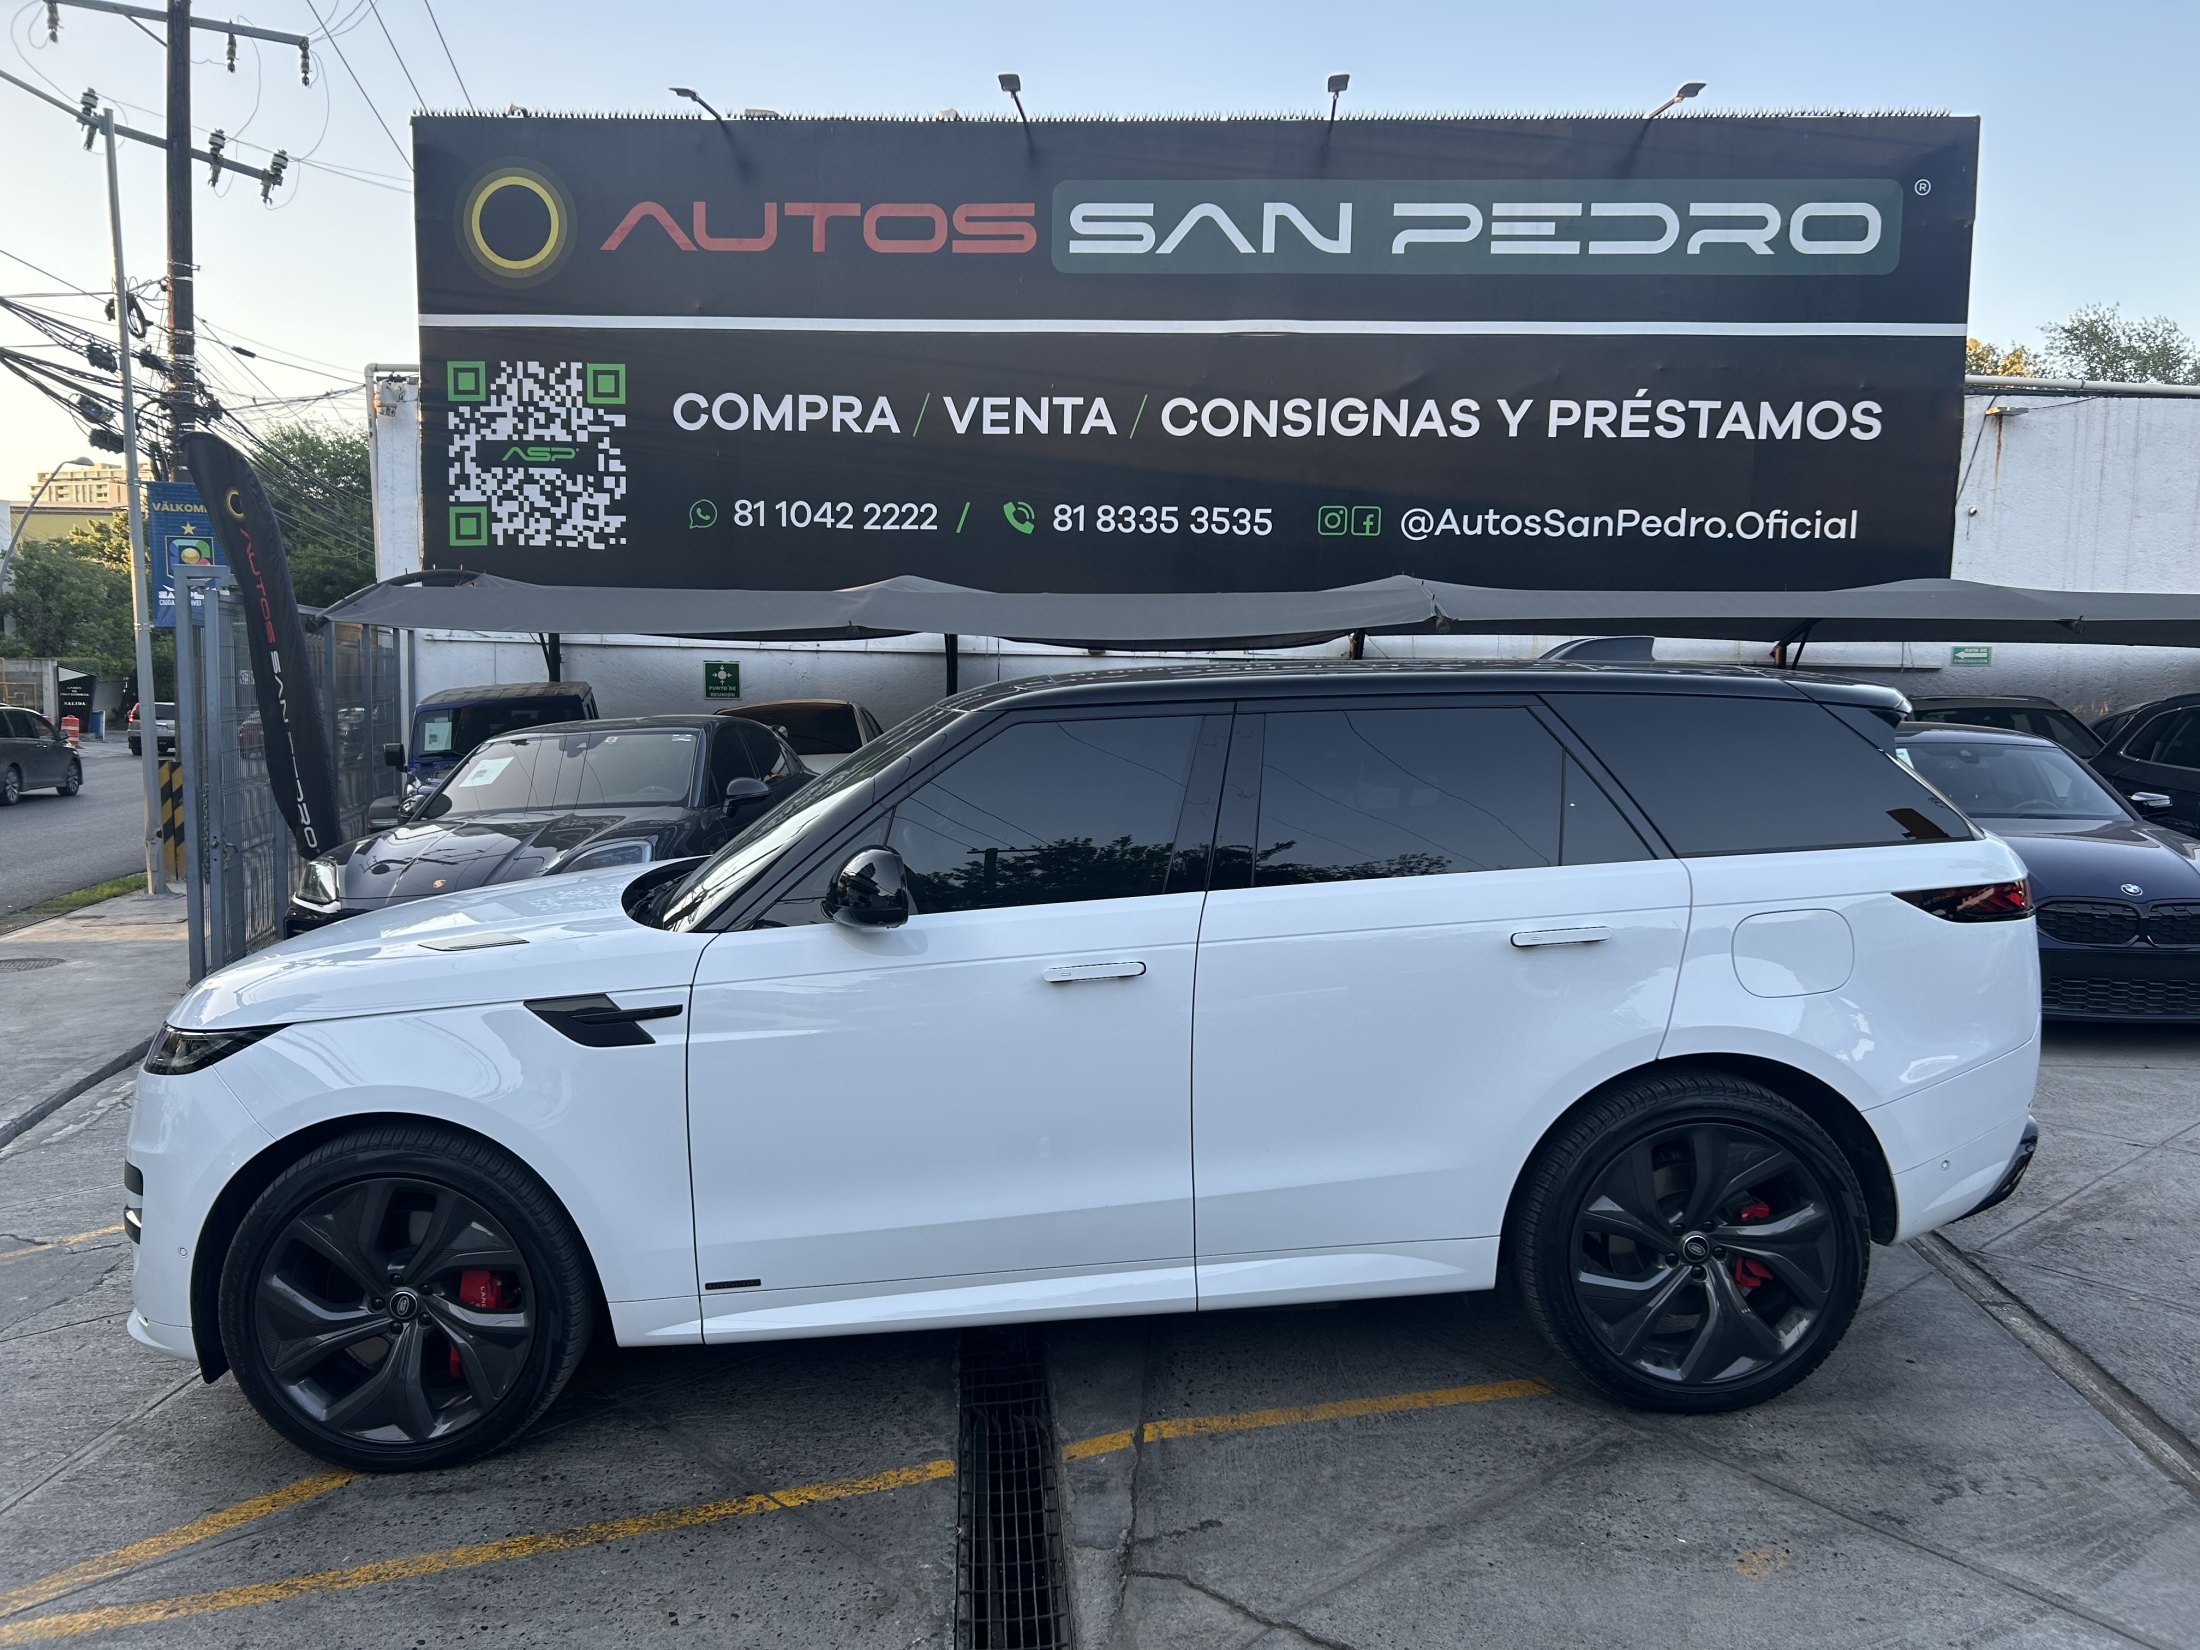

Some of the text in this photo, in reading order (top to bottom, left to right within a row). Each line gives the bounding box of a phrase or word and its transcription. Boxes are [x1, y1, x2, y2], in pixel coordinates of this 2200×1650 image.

[603, 203, 1036, 253] AUTOS
[1068, 202, 1353, 255] SAN
[1391, 202, 1882, 255] PEDRO
[672, 392, 901, 434] COMPRA
[942, 395, 1118, 435] VENTA
[1161, 397, 1481, 438] CONSIGNAS
[1496, 398, 1534, 437] Y
[1547, 388, 1883, 441] PRÉSTAMOS
[501, 445, 577, 462] ASP
[152, 501, 208, 513] VÄLKOM
[733, 499, 765, 527] 81
[775, 500, 854, 530] 1042
[863, 502, 938, 530] 2222
[1052, 503, 1273, 536] 81 8335 3535
[1400, 507, 1858, 541] @AutosSanPedro.Oficial
